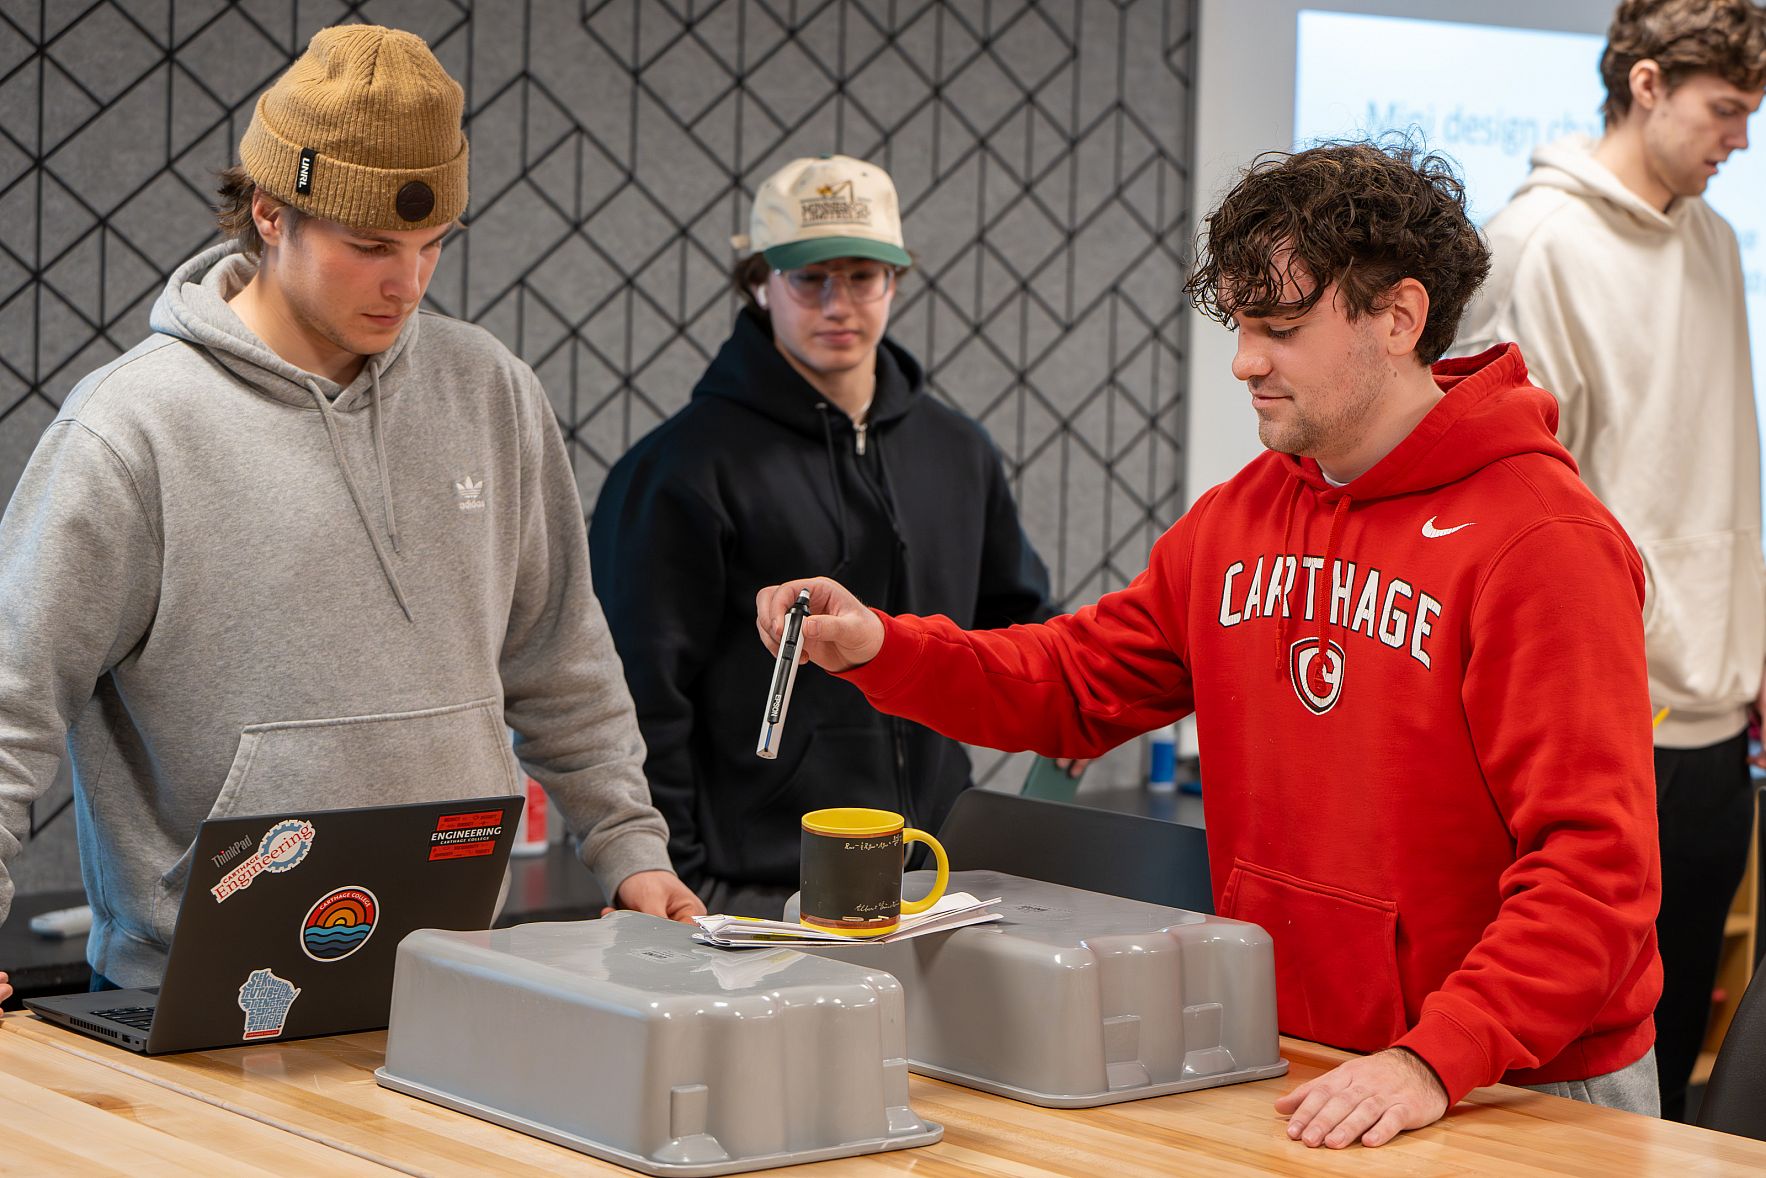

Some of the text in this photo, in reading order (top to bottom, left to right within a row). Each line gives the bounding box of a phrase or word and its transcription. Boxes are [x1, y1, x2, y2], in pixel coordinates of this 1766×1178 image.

[1443, 104, 1540, 157] design
[298, 157, 311, 188] UNRL
[1218, 553, 1442, 672] CARTHAGE
[770, 694, 782, 717] EPSON
[431, 826, 502, 841] ENGINEERING
[211, 834, 253, 868] ThinkPad
[214, 824, 313, 900] Engineering
[222, 854, 260, 884] CARTHAGE
[320, 892, 371, 910] CARTHAGE COLLEGE
